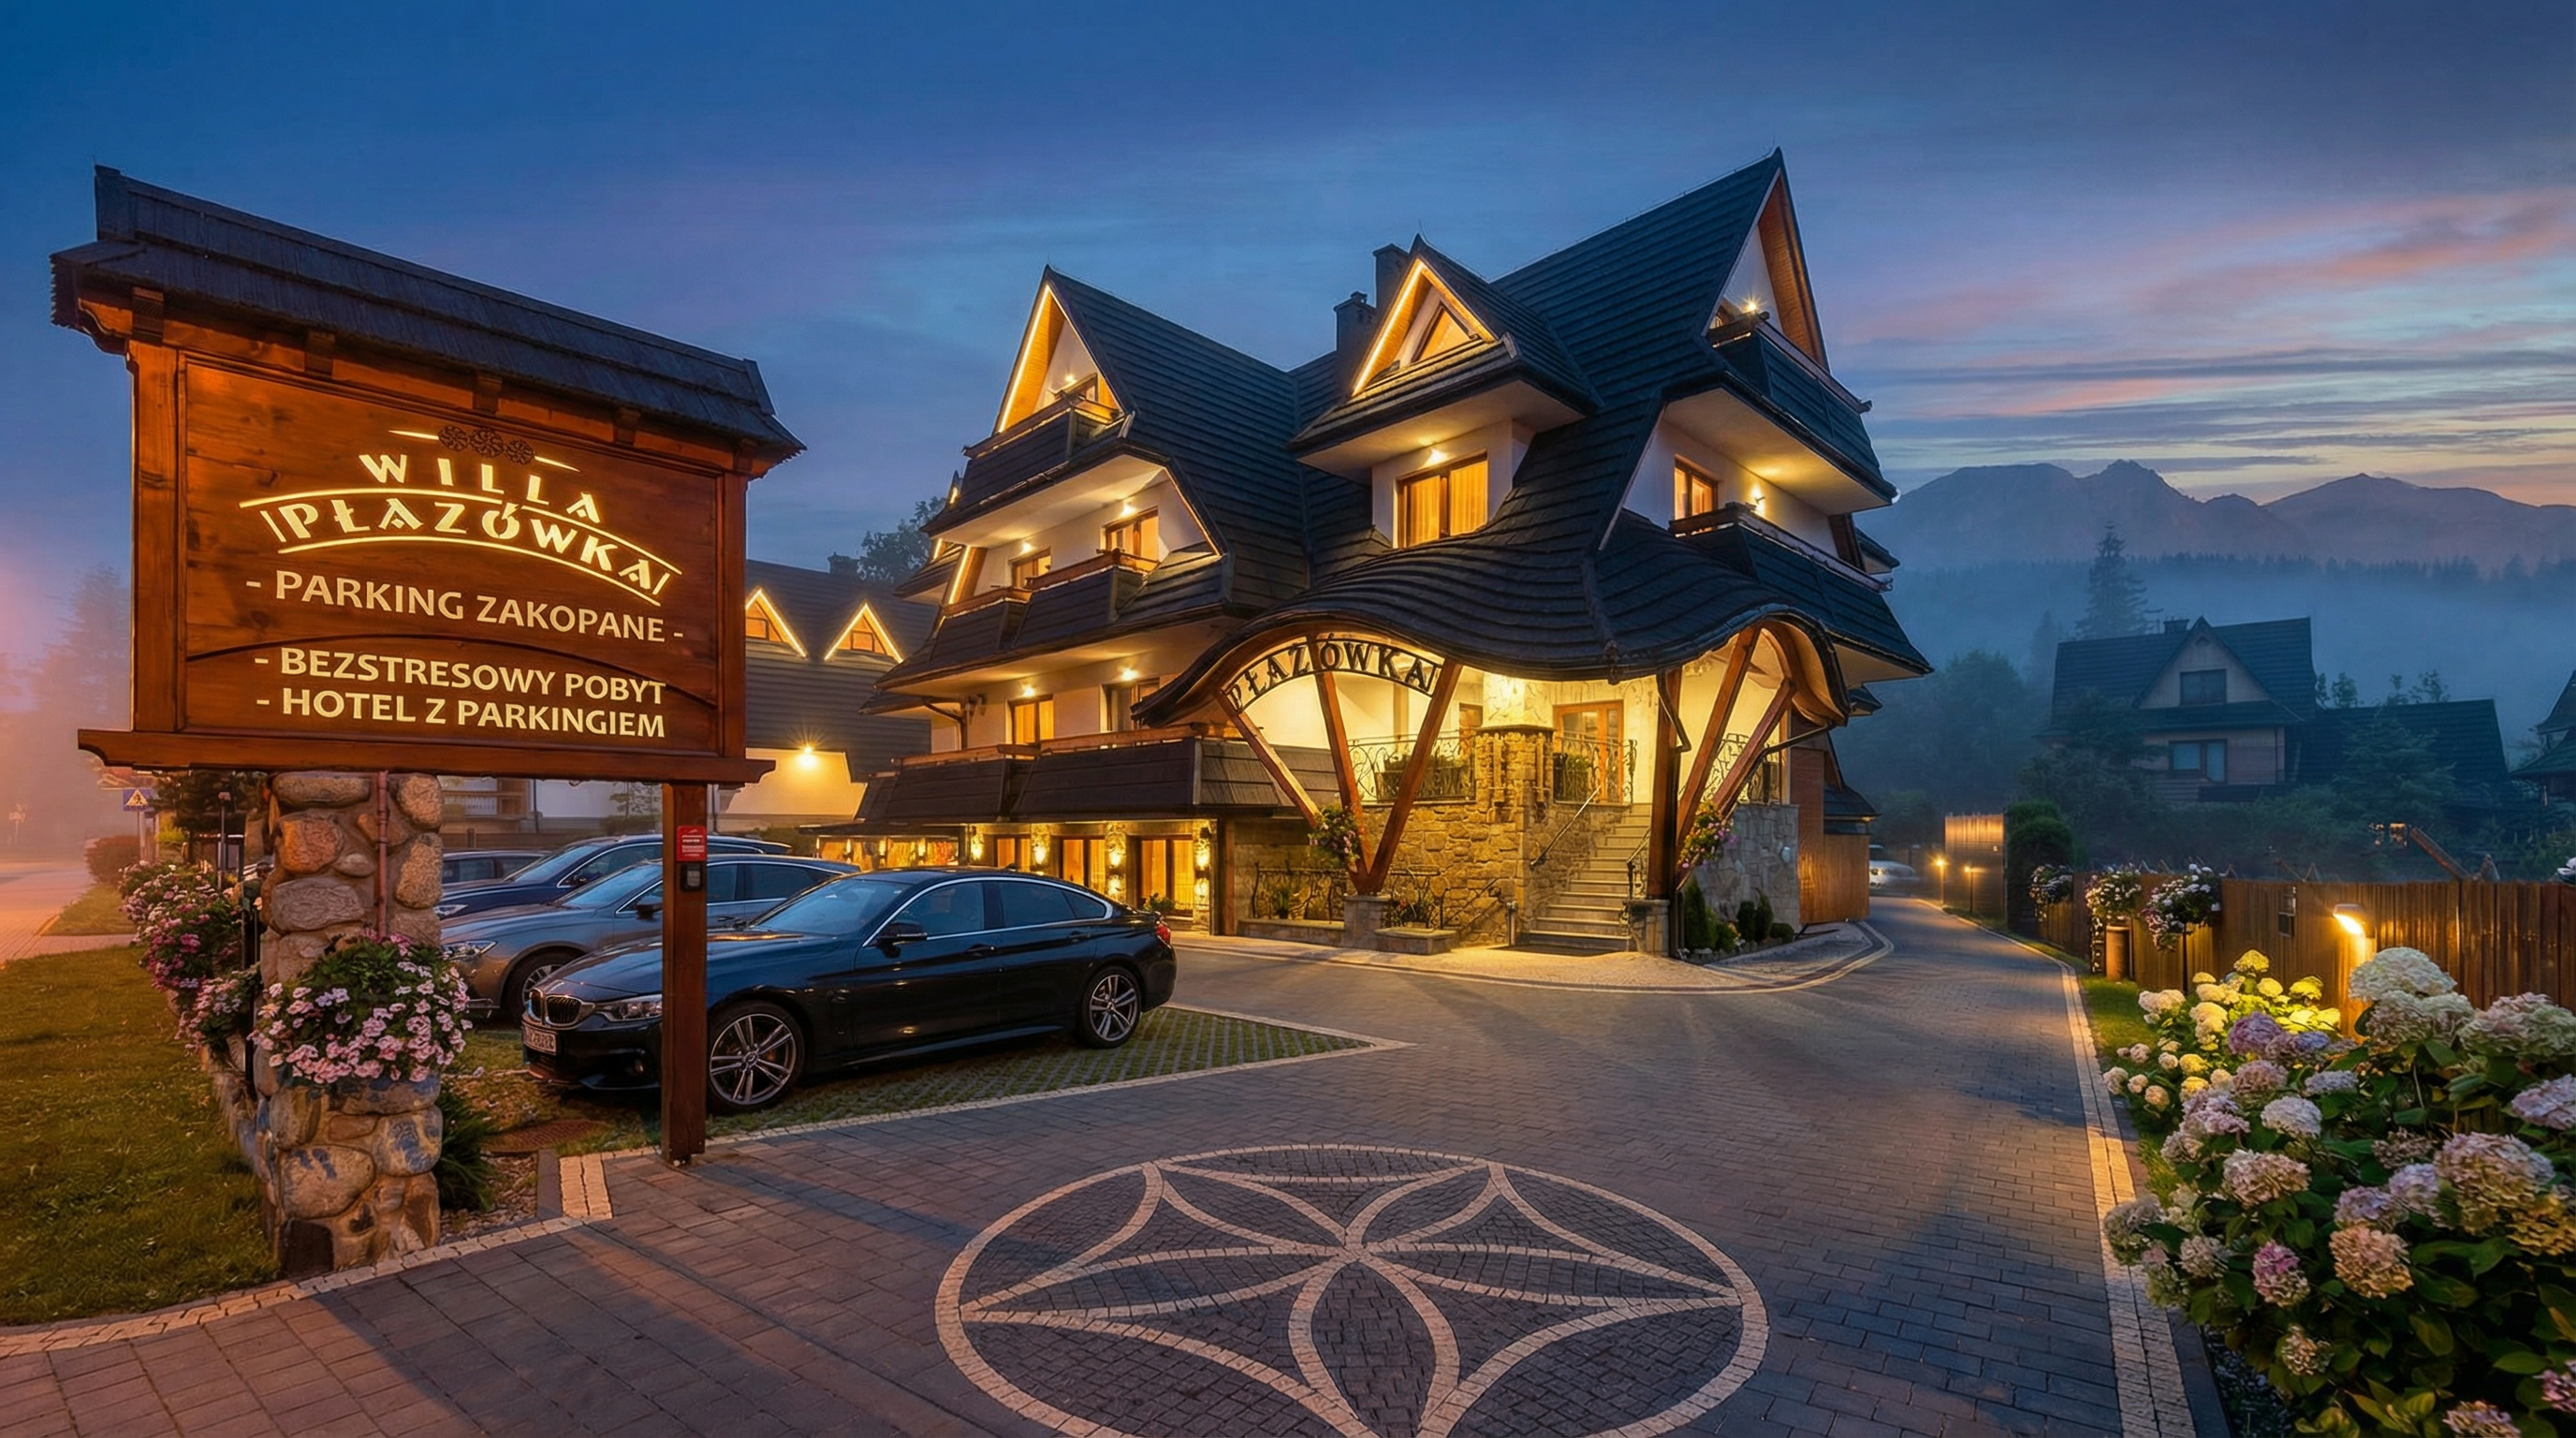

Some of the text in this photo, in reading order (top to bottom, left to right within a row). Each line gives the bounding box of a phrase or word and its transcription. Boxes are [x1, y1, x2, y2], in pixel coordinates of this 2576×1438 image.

[359, 454, 601, 523] WILLA
[279, 497, 651, 589] PŁAZÓWKA
[275, 570, 463, 620] PARKING
[476, 596, 666, 642] ZAKOPANE
[280, 647, 555, 695] BEZSTRESOWY
[565, 673, 666, 705] POBYT
[283, 687, 416, 723] HOTEL
[425, 699, 446, 725] Z
[458, 700, 665, 738] PARKINGIEM
